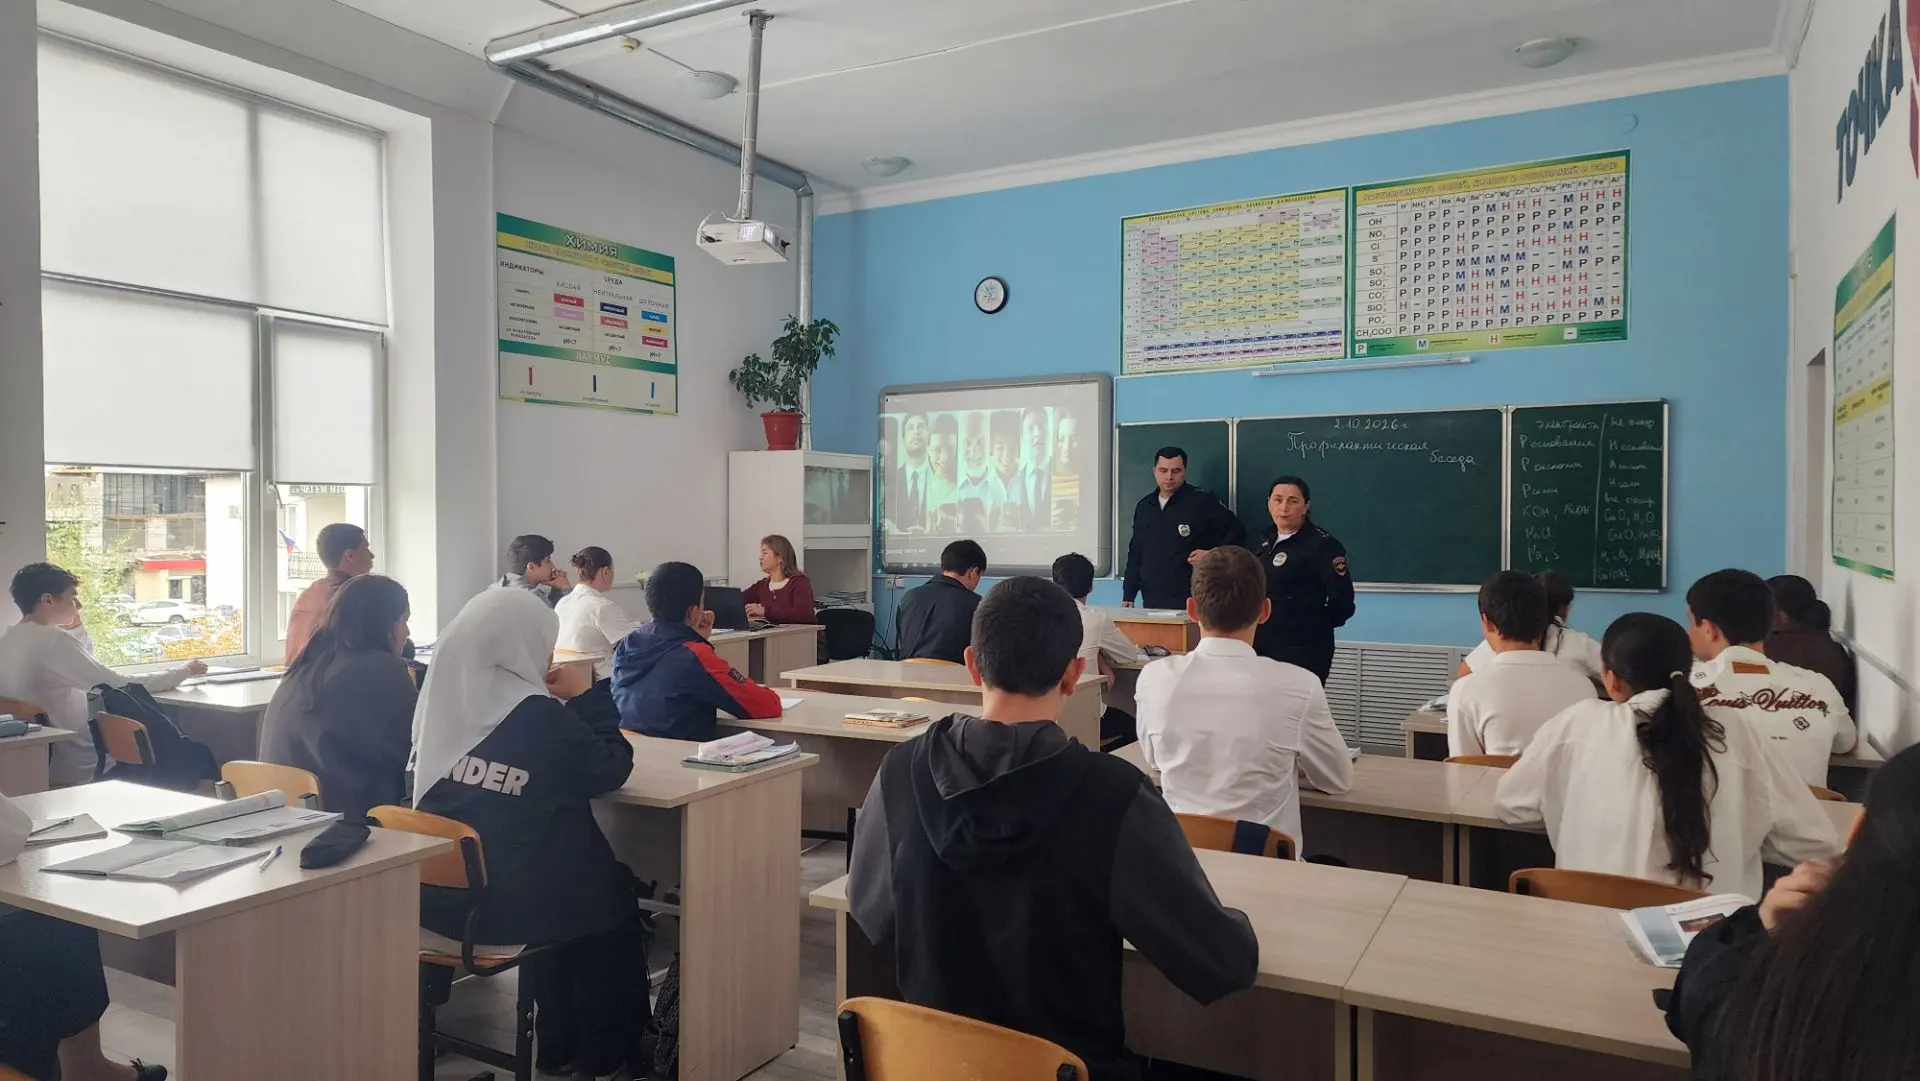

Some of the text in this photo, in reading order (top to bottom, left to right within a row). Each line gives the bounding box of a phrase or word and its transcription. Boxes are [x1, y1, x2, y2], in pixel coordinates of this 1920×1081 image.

[1836, 0, 1904, 204] ТОЧКА
[1400, 202, 1621, 235] Р Р Р Р Р Р Р Р Р Р Р Р Р Р Р
[565, 233, 618, 257] ХИМИЯ
[1400, 216, 1620, 248] Р Р Р Р Н Р Р Р Р Р Р М Р Р Р
[499, 260, 545, 275] ИНДИКАТОРЫ
[603, 276, 623, 285] СРЕДА
[1414, 275, 1421, 284] Р
[1428, 274, 1435, 282] Р
[1456, 271, 1465, 279] М
[1472, 270, 1479, 278] Н
[1486, 268, 1495, 276] М
[1501, 267, 1509, 275] Р
[1516, 265, 1524, 274] Р
[1532, 264, 1540, 272] Р
[1563, 260, 1572, 268] М
[1580, 259, 1587, 268] Р
[1596, 257, 1604, 266] Р
[1612, 256, 1620, 264] Р
[1400, 314, 1406, 322] Р
[1414, 313, 1420, 321] Р
[1442, 310, 1449, 318] Р
[1456, 309, 1464, 317] Н
[1471, 308, 1479, 316] Н
[1486, 306, 1494, 315] Н
[1500, 305, 1509, 313] М
[1516, 304, 1524, 312] Н
[1532, 303, 1540, 311] Н
[1547, 301, 1556, 310] Н
[1563, 300, 1571, 308] Н
[1579, 298, 1587, 307] Н
[1594, 297, 1604, 306] М
[1612, 296, 1620, 304] Н
[1400, 326, 1406, 334] Р
[1414, 325, 1420, 334] Р
[1428, 324, 1435, 332] Р
[1442, 323, 1449, 331] Р
[1456, 322, 1463, 330] Р
[1486, 320, 1493, 328] Р
[1501, 318, 1508, 326] Р
[1516, 317, 1524, 326] Р
[1532, 316, 1539, 324] Р
[1547, 315, 1554, 323] Р
[1563, 313, 1571, 322] Р
[1579, 312, 1586, 320] Р
[1595, 311, 1602, 319] Р
[1611, 308, 1620, 318] Р
[1418, 340, 1427, 348] М
[1490, 335, 1498, 344] Н
[575, 352, 613, 365] ЛАМУС
[1288, 432, 1428, 459] Профилактическая
[1429, 450, 1476, 472] беседа
[449, 755, 530, 796] NDER
